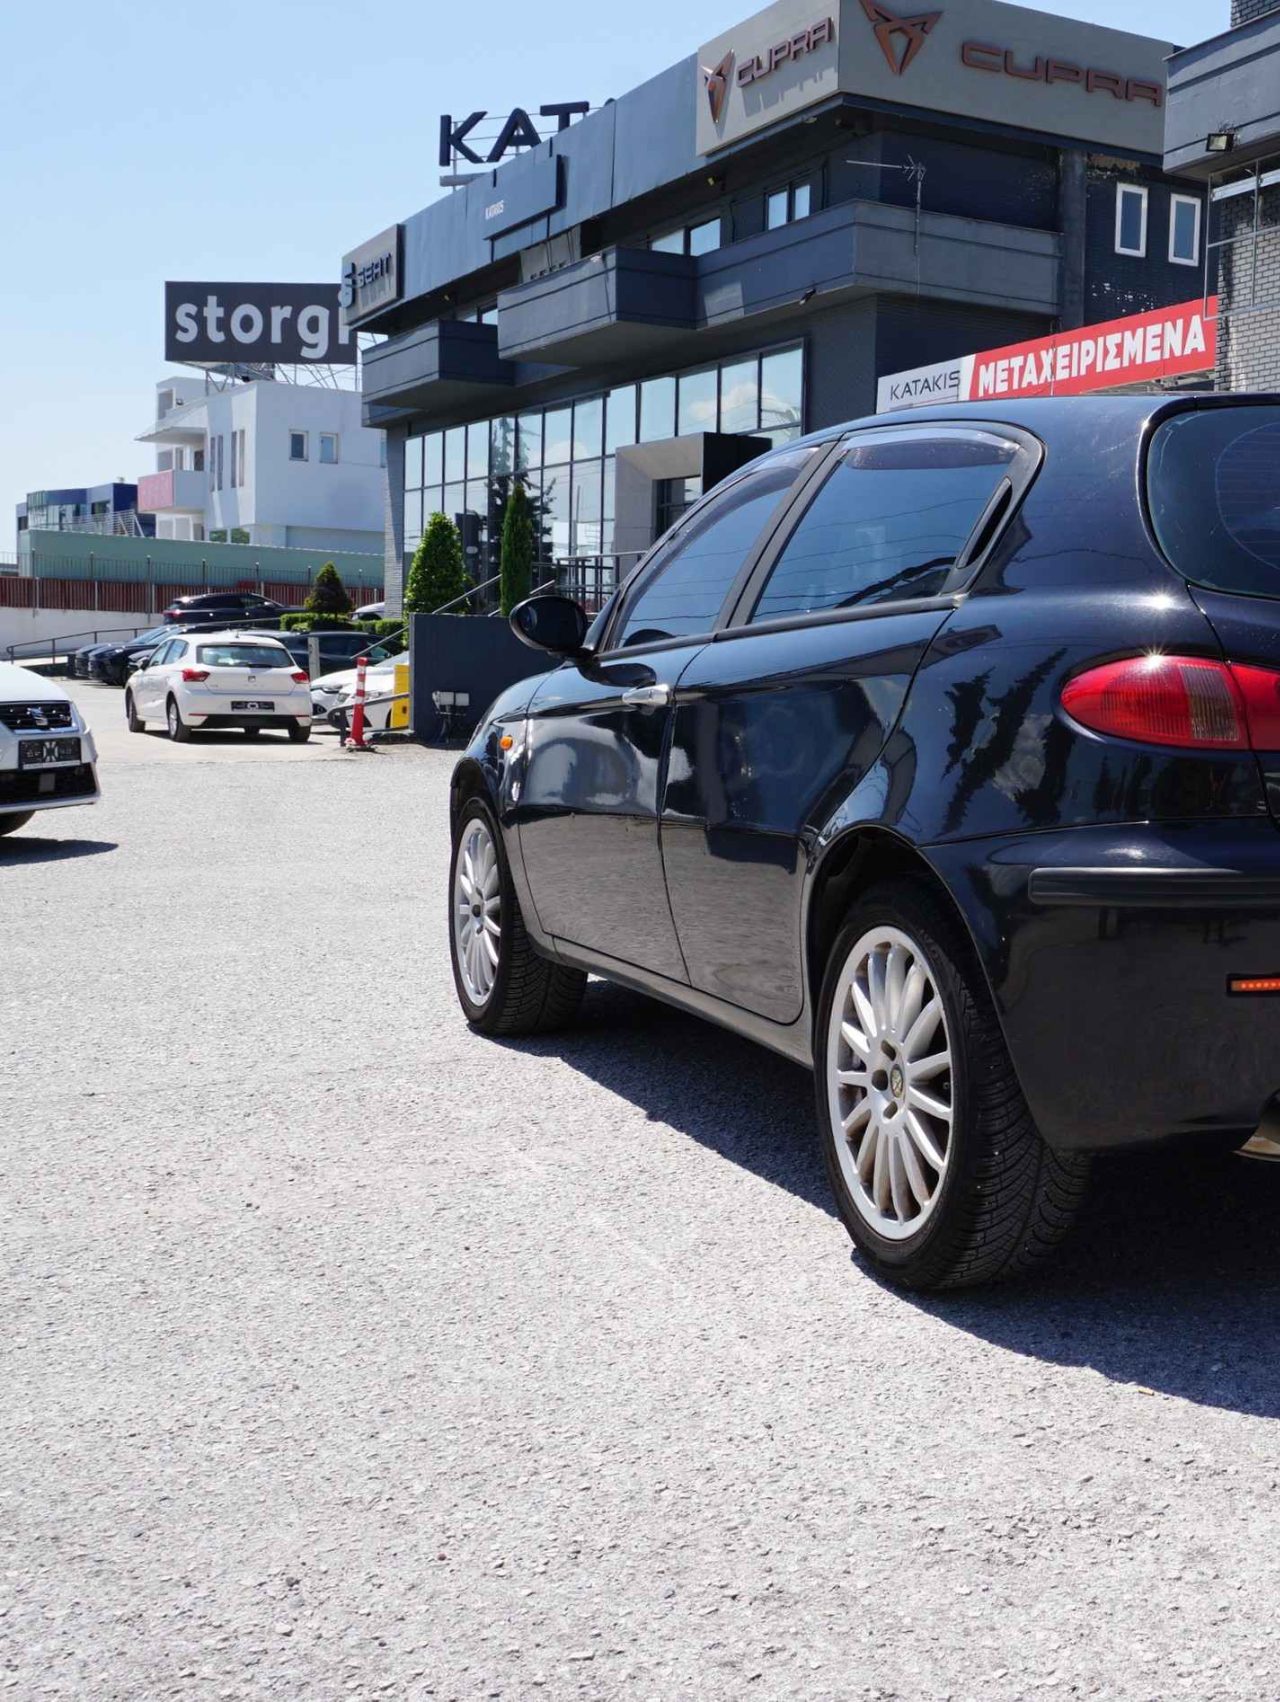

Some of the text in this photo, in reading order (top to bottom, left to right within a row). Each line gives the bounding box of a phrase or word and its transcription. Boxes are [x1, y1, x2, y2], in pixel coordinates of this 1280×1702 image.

[736, 17, 833, 87] CUPRA
[961, 41, 1162, 107] CUPRA
[439, 98, 615, 166] KAT
[890, 370, 961, 400] KATAKIS
[978, 315, 1206, 397] ΜΕΤΑΧΕΙΡΙΣΜΕΝΑ
